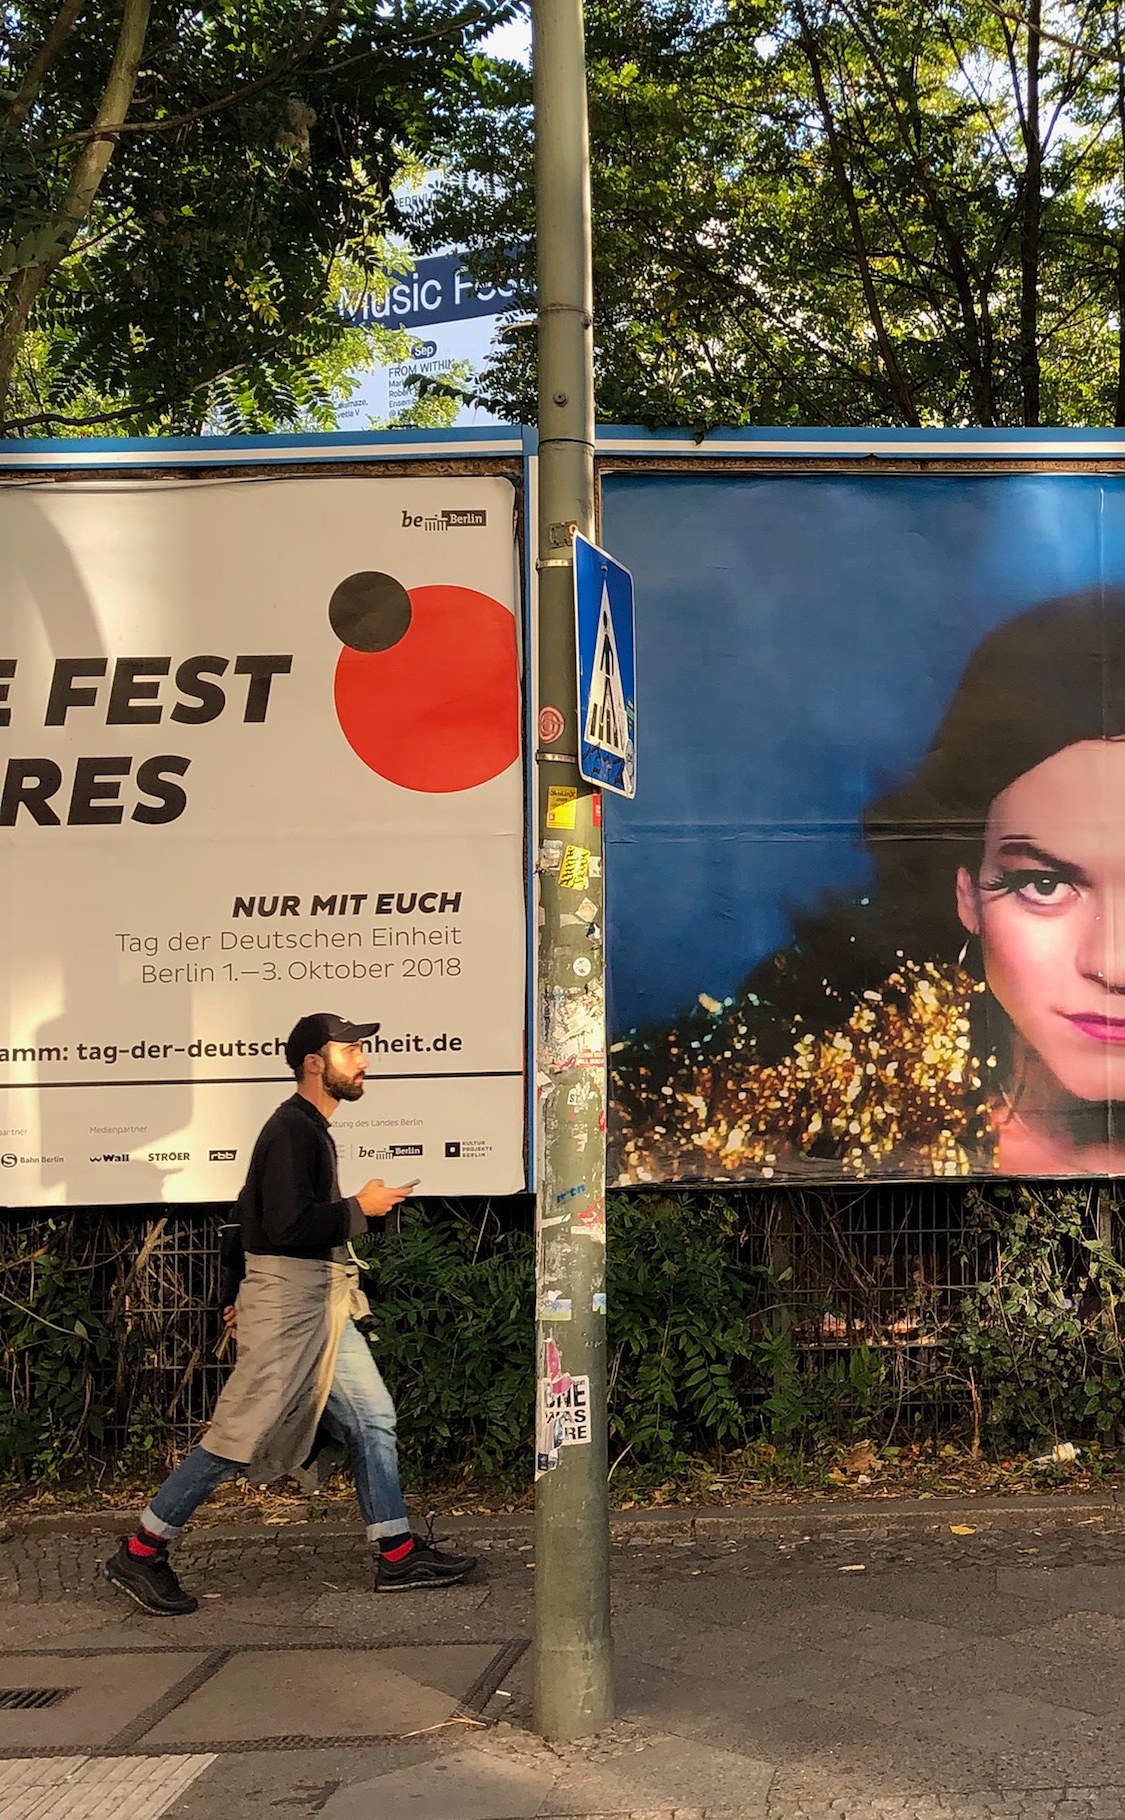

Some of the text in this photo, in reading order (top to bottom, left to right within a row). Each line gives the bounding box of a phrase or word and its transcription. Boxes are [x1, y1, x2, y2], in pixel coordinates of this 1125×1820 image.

[338, 272, 441, 321] Music
[388, 365, 417, 379] FROM
[402, 510, 483, 527] be Berlin
[44, 655, 293, 726] FEST
[0, 755, 192, 827] RES
[232, 891, 462, 918] NUR MIT EUCH
[115, 926, 462, 957] Tag der Deutschen Einheit
[142, 963, 214, 983] Berlin
[288, 960, 394, 980] Oktober
[402, 957, 461, 978] 2018
[90, 1125, 147, 1134] Medienpartner
[371, 1119, 399, 1127] Landes
[400, 1118, 423, 1126] Berlin
[103, 1153, 130, 1162] Wall
[148, 1152, 191, 1162] STRÖER
[211, 1151, 236, 1161] rbb
[359, 1146, 421, 1158] be Berlin
[20, 1156, 40, 1164] Bahn
[41, 1155, 65, 1163] Berlin
